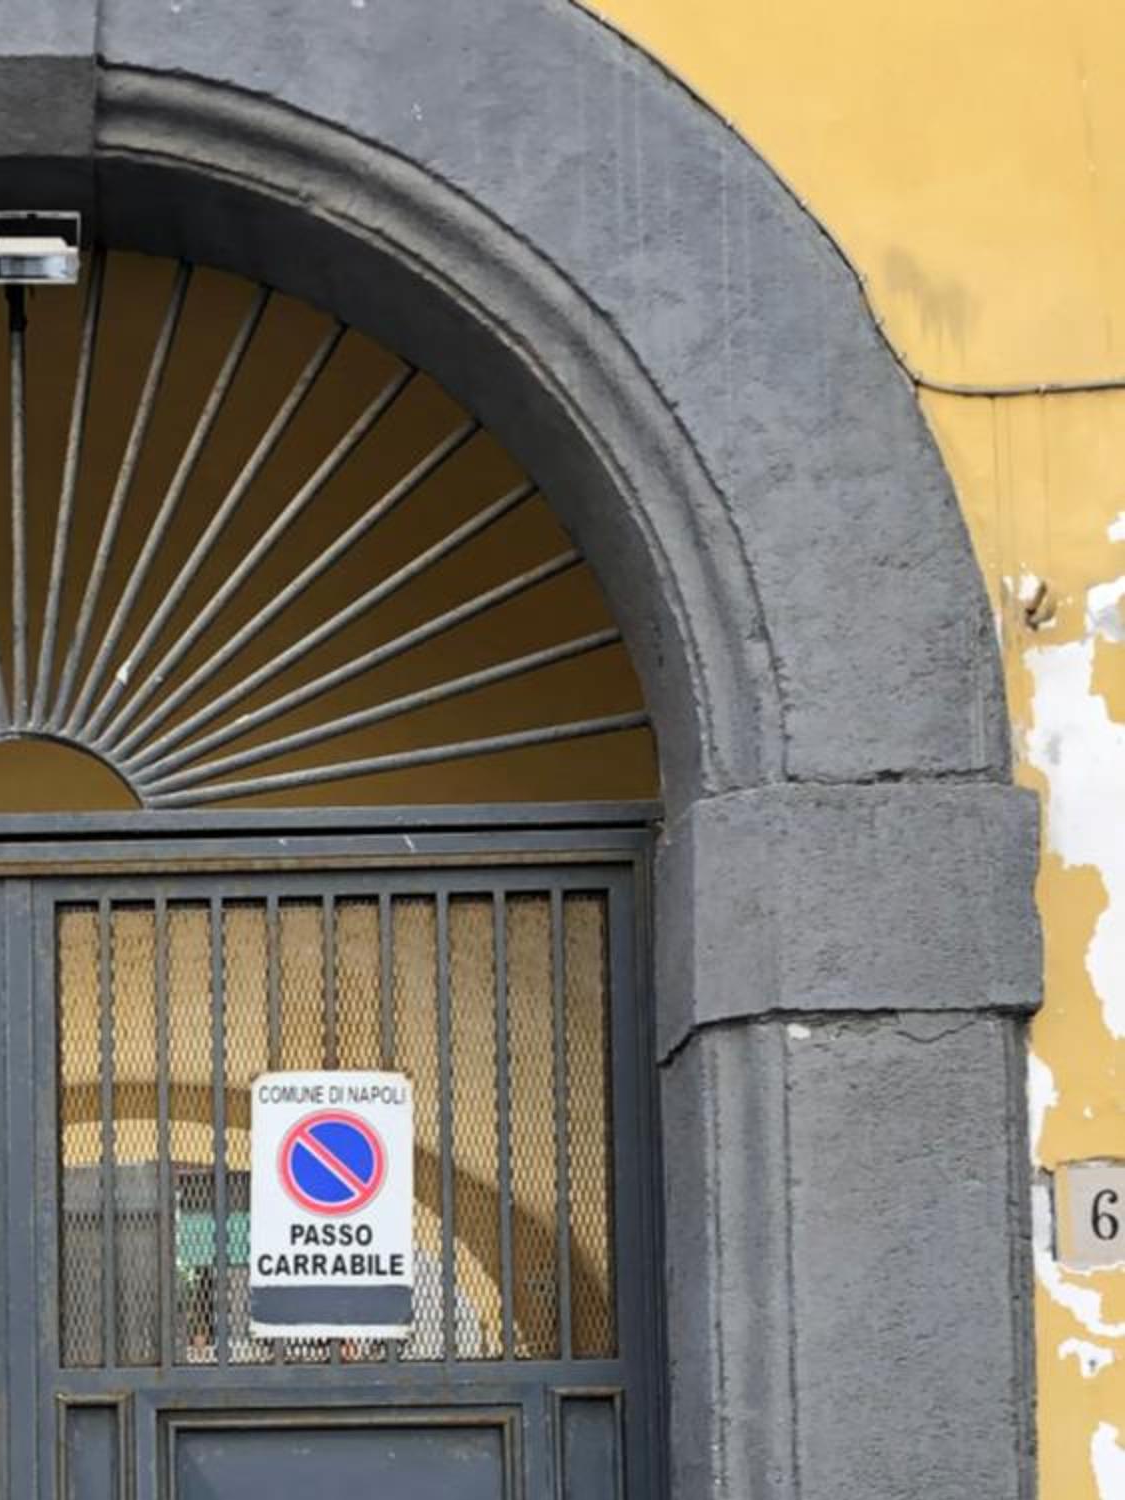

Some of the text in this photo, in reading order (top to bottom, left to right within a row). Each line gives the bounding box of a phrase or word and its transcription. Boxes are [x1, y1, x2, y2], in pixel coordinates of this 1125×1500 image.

[258, 1085, 406, 1104] COMUNE DI NAPOLI
[1091, 1188, 1119, 1241] 6
[290, 1224, 373, 1246] PASSO
[257, 1254, 404, 1276] CARRABILE
